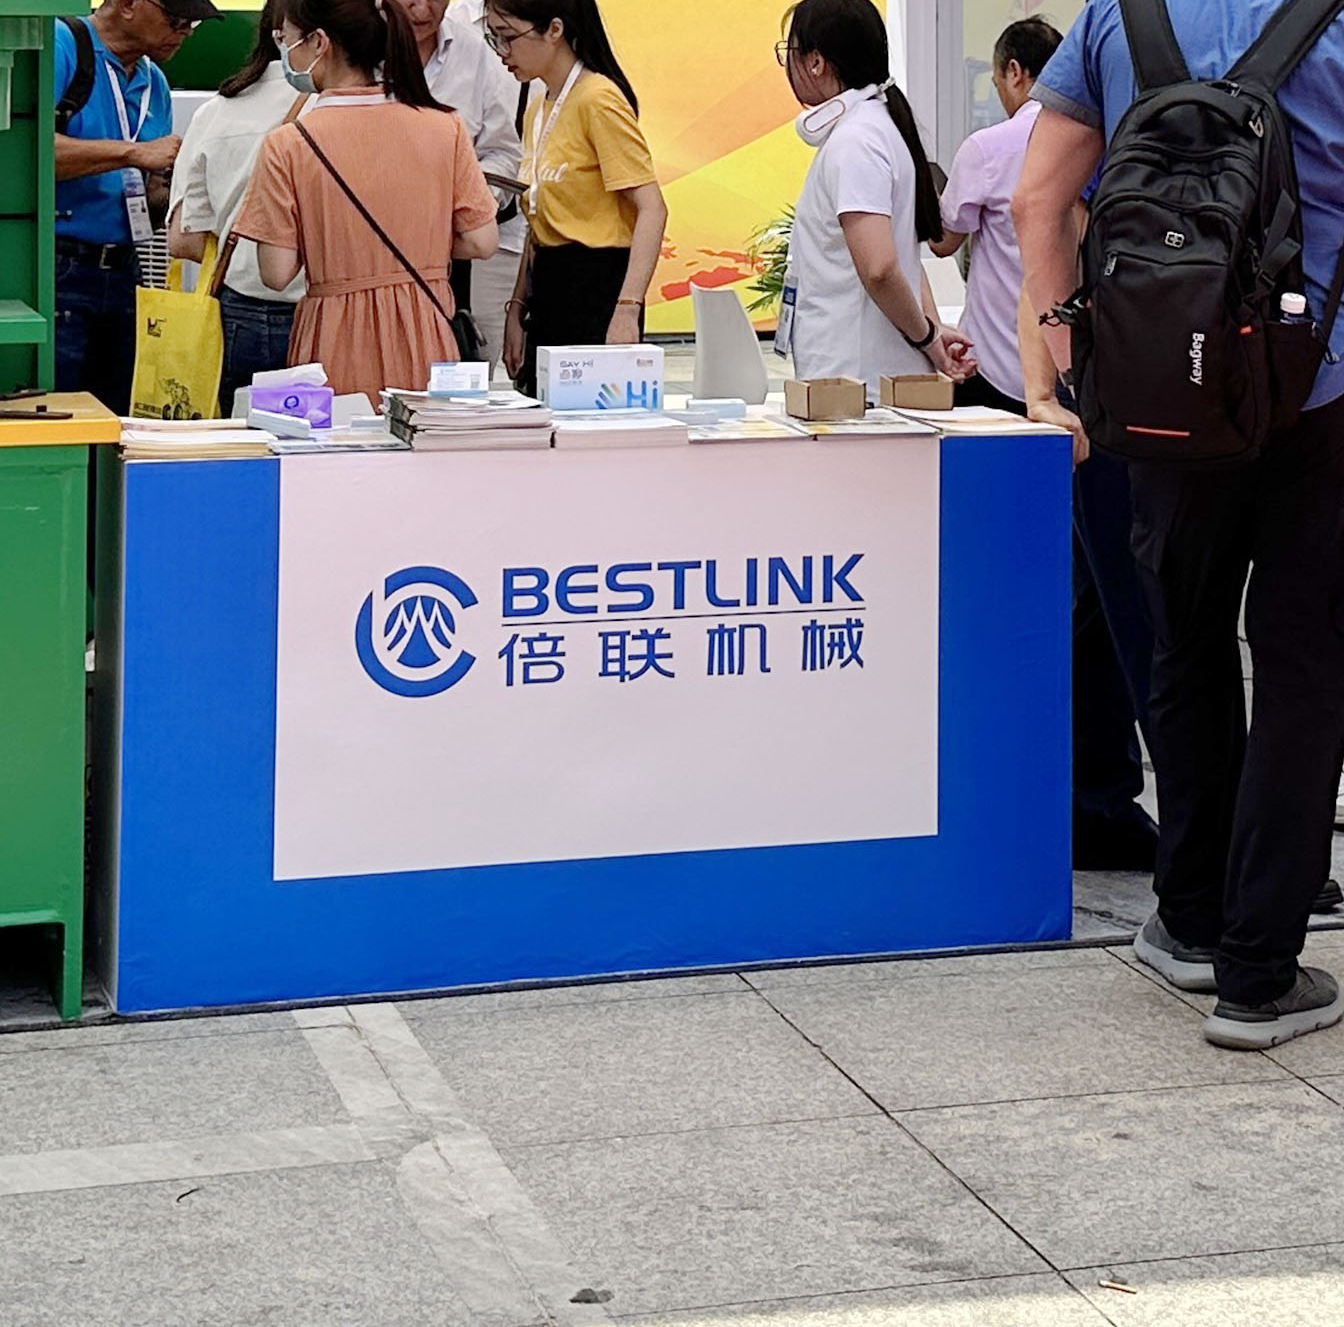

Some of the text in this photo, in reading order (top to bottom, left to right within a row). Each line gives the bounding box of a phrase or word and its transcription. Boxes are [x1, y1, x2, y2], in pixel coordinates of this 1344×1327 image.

[1189, 332, 1205, 386] Bagway
[626, 379, 658, 410] Hi
[501, 553, 866, 619] BESTLINK
[498, 618, 866, 687] 倍联机械
